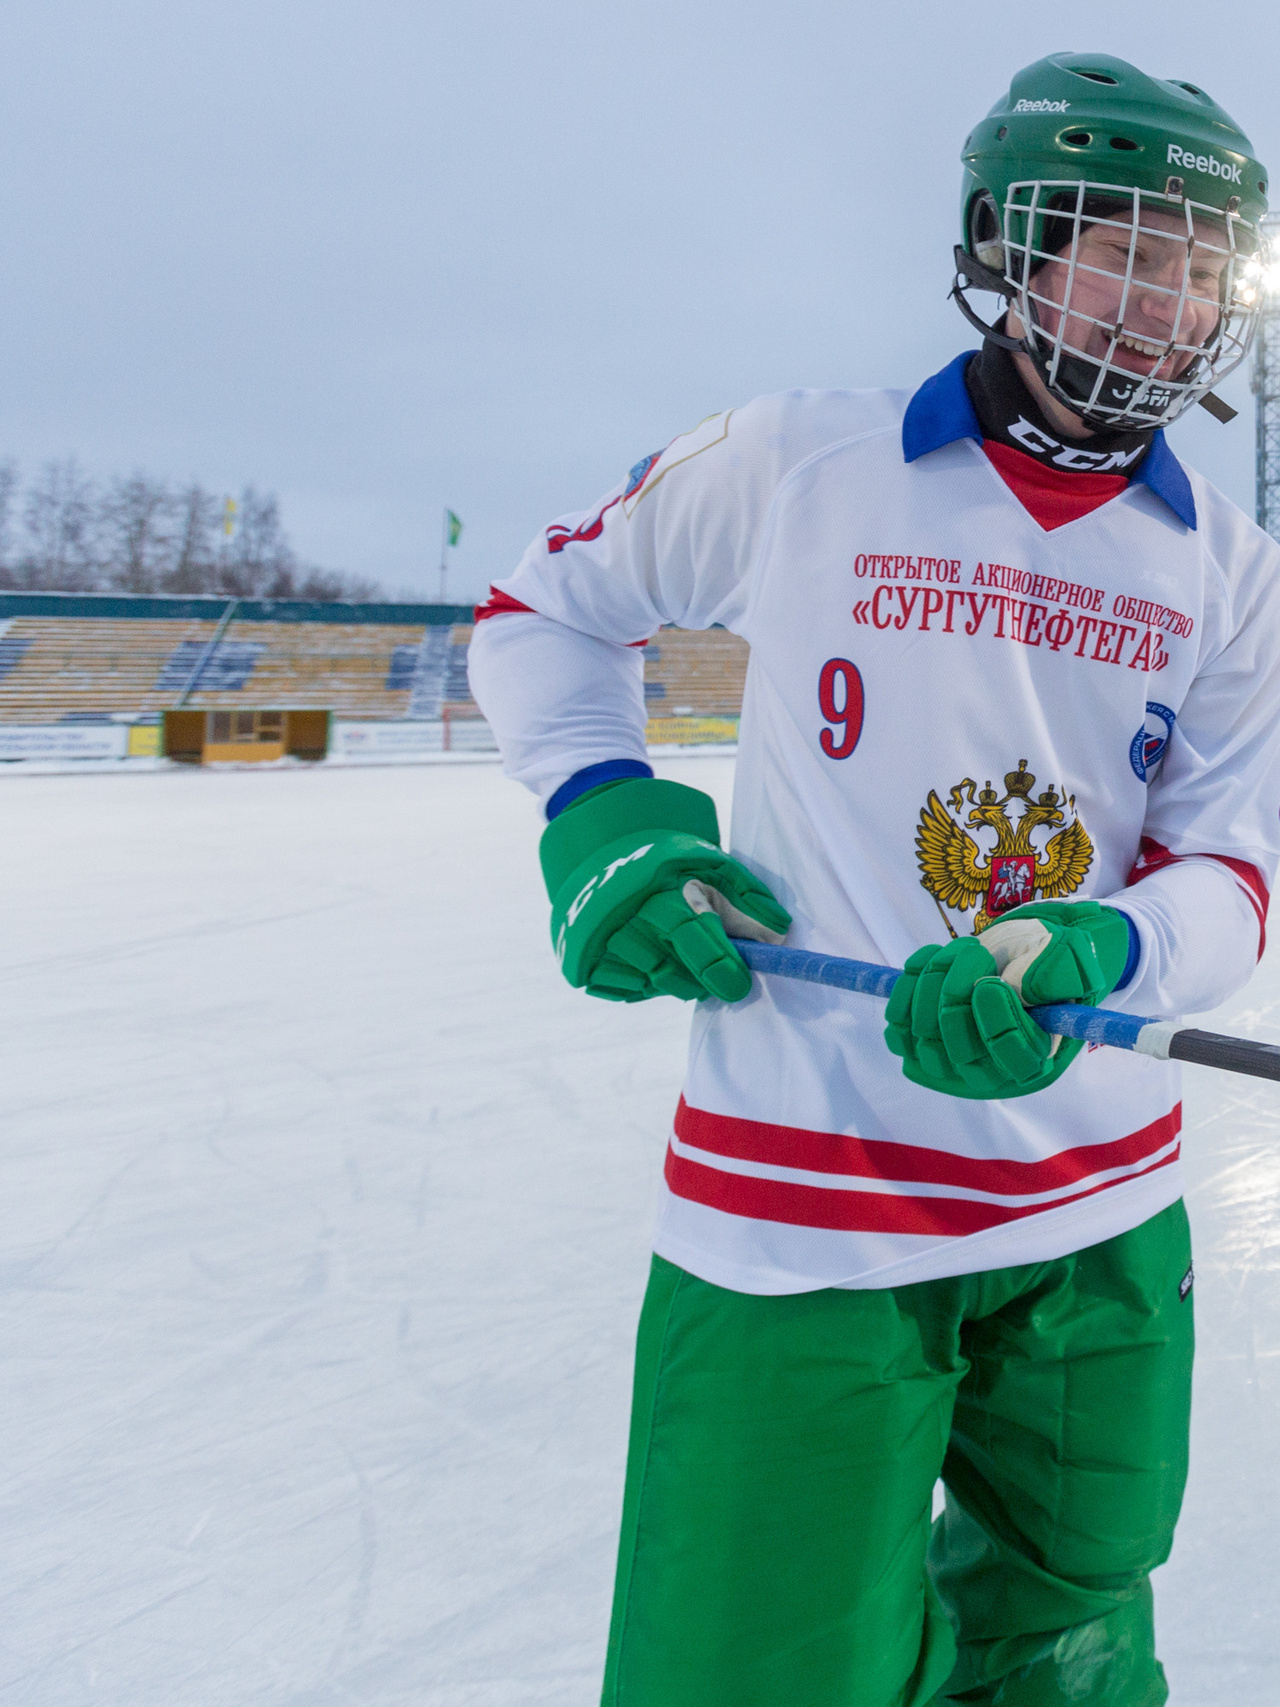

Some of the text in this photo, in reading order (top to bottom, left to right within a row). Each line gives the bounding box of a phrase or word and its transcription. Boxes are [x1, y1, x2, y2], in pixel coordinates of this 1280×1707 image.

[1012, 98, 1071, 114] Reebok
[1167, 143, 1243, 186] Reebok
[1007, 414, 1146, 471] CCM
[854, 553, 1194, 639] ОТКРЫТОЕ АКЦИОНЕРНОЕ ОБЩЕСТВО
[818, 657, 866, 760] 9
